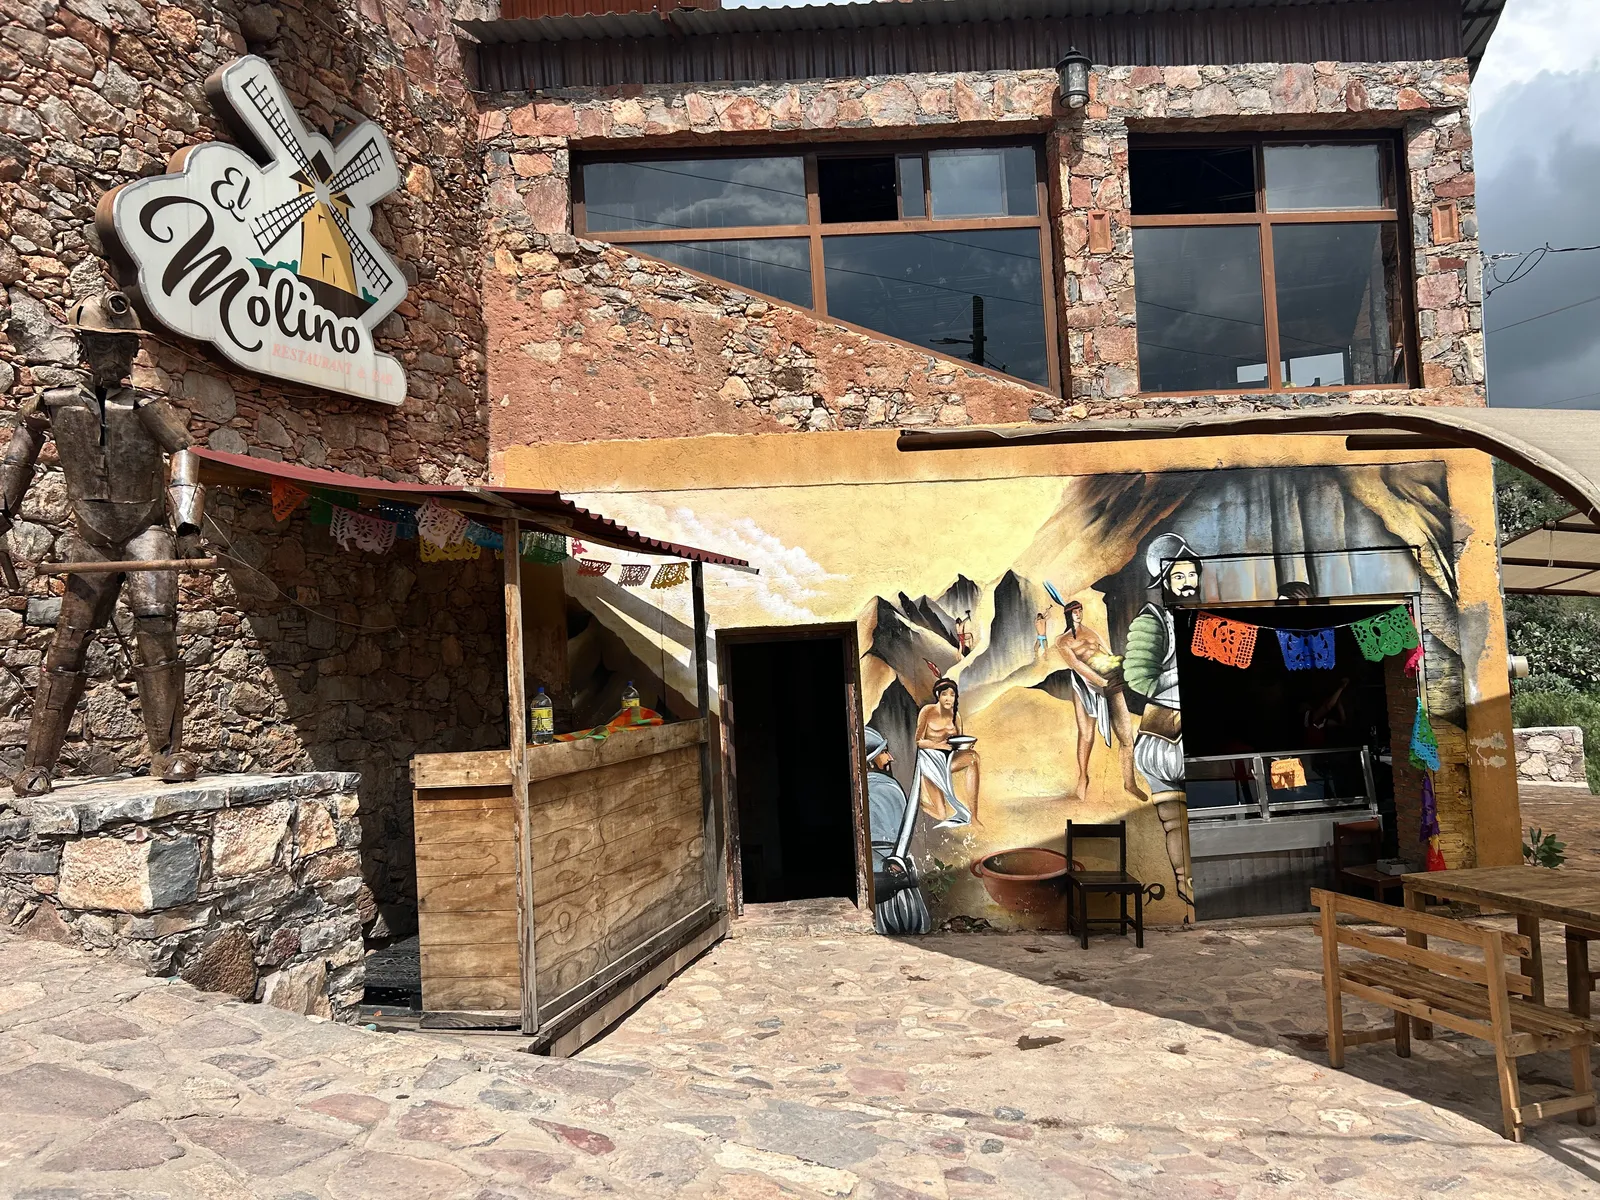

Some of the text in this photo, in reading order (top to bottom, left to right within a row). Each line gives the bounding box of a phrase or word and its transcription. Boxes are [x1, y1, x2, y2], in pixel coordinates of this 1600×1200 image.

[211, 167, 251, 222] El
[139, 195, 360, 354] Molino
[272, 343, 394, 386] RESTAURANT & BAR
